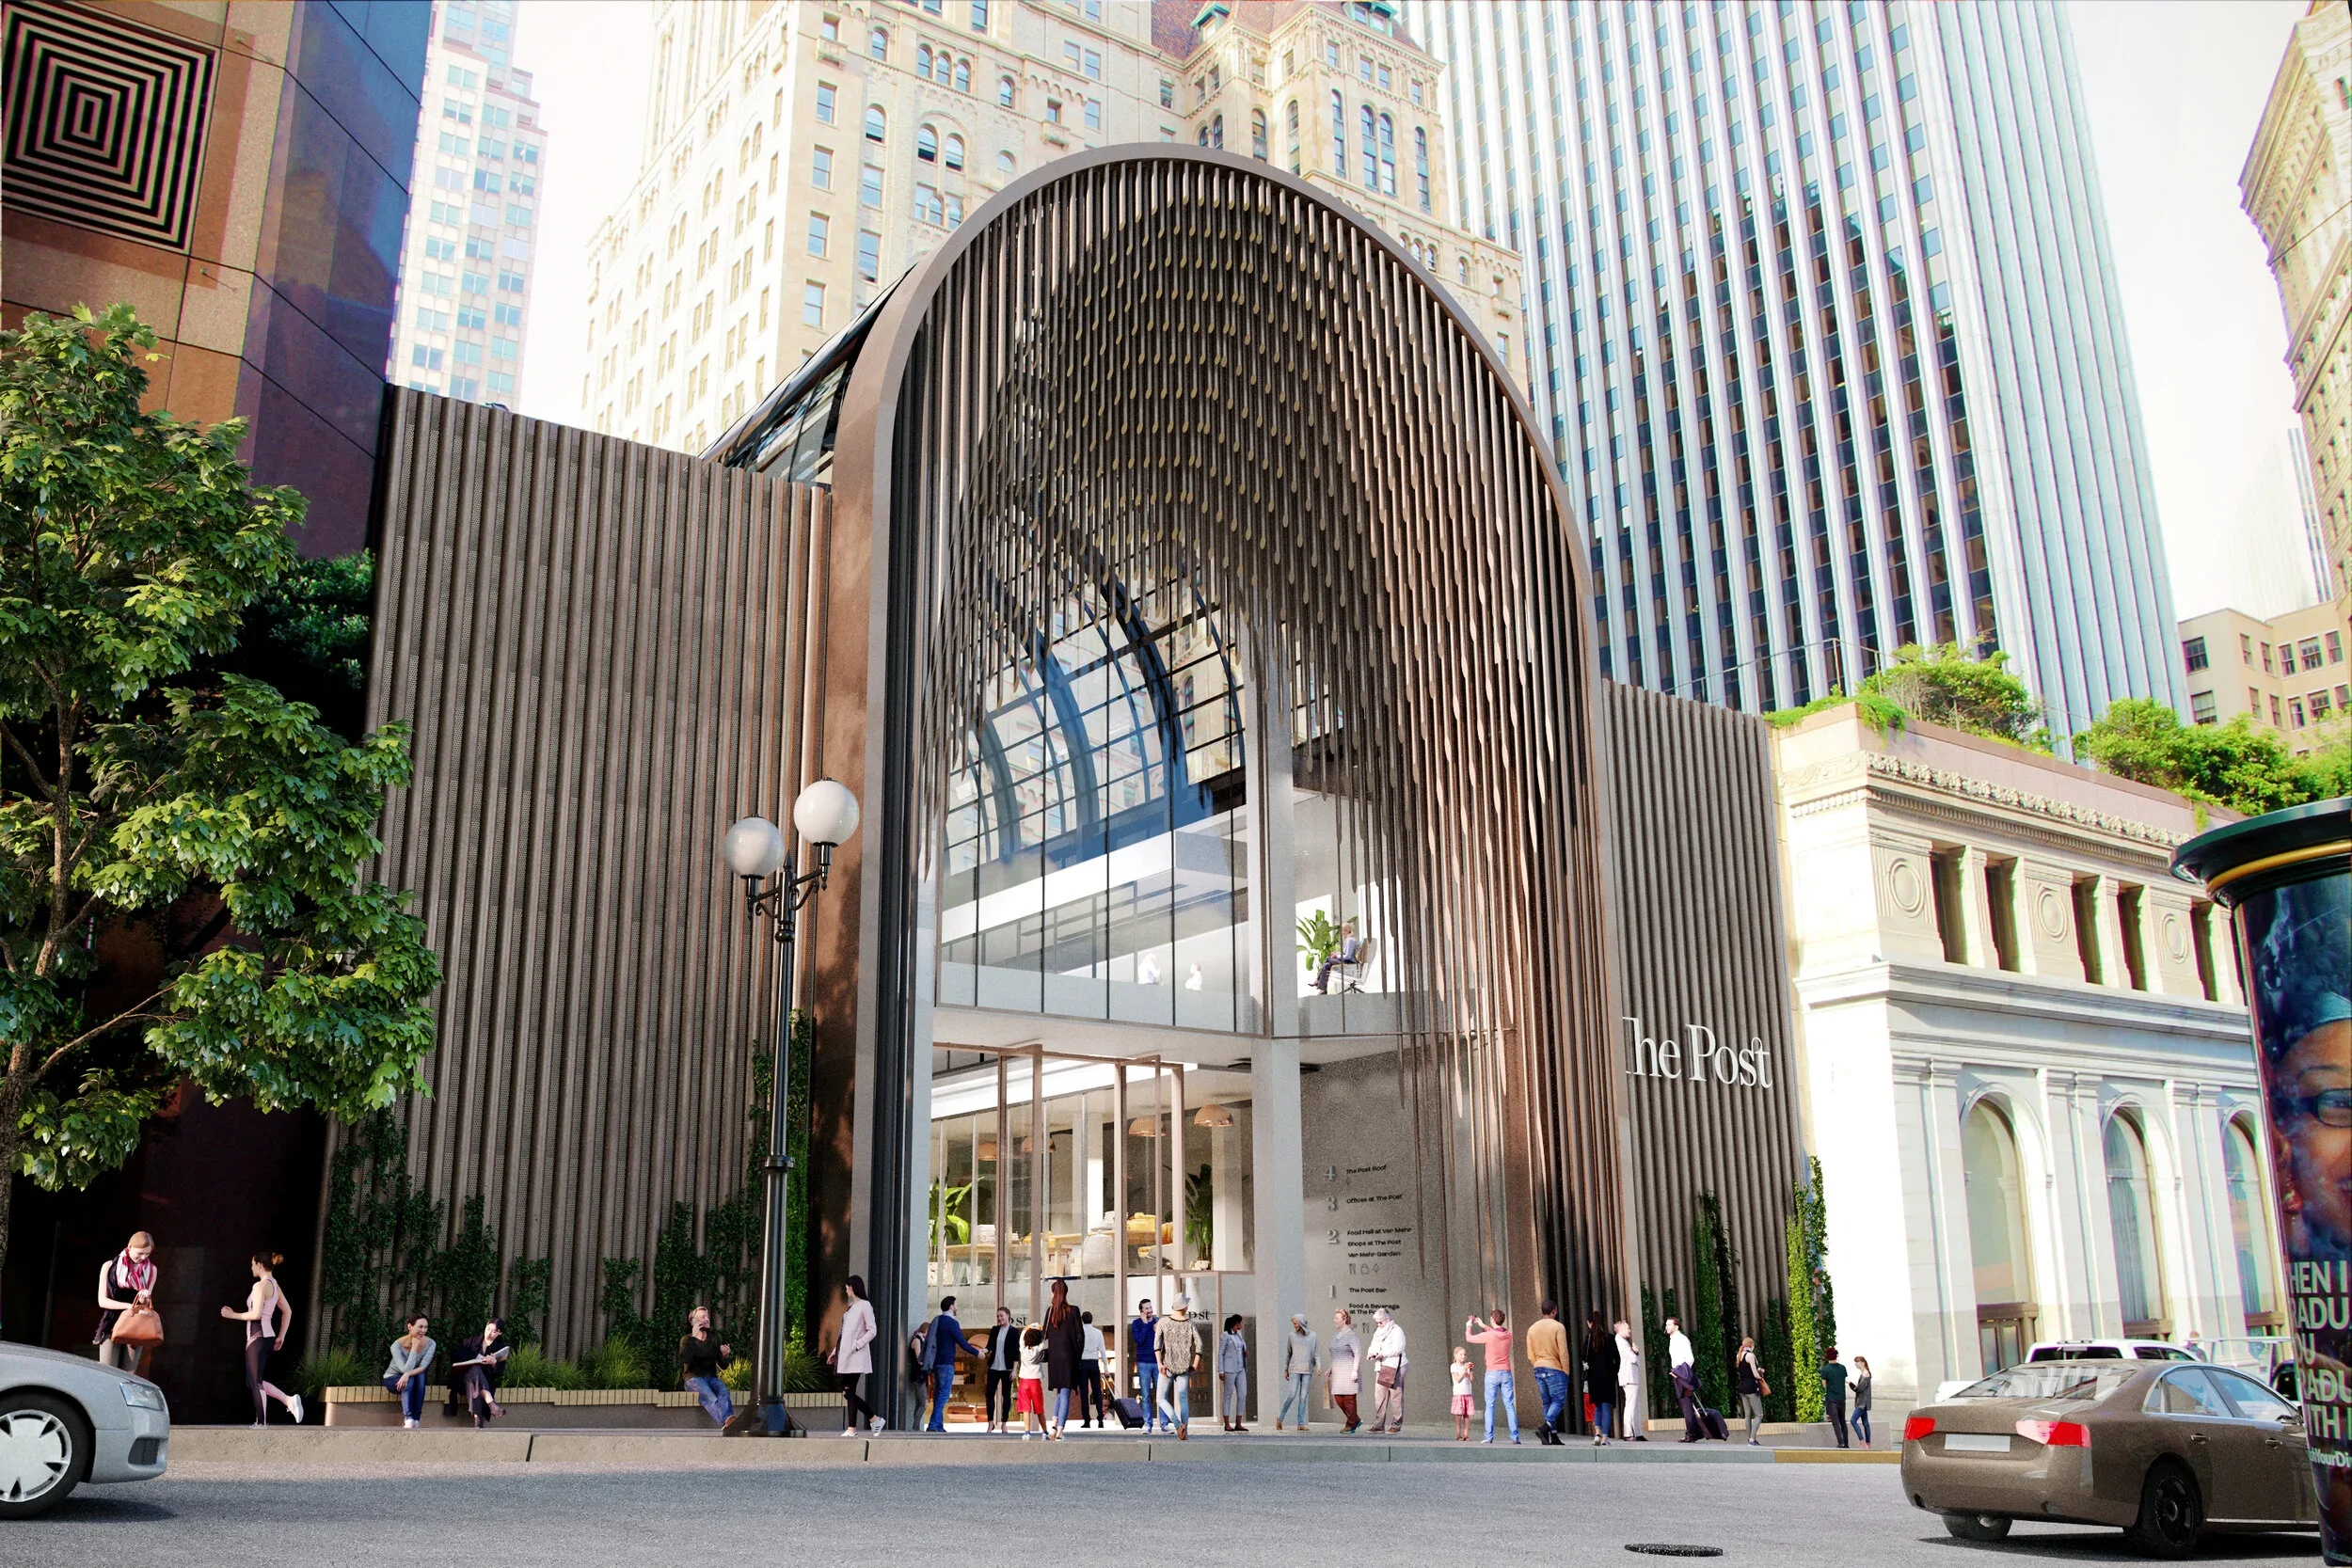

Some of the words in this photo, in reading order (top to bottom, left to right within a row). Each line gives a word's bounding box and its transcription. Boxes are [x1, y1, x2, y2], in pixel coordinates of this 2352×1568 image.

[1623, 1017, 1681, 1080] he
[1685, 1023, 1773, 1089] Post
[1324, 1166, 1336, 1181] 4
[1327, 1196, 1337, 1211] 3
[1327, 1228, 1340, 1244] 2
[2289, 1260, 2331, 1293] HEN
[1328, 1284, 1335, 1299] 1
[2296, 1332, 2315, 1365] OU
[2308, 1403, 2341, 1440] ITH
